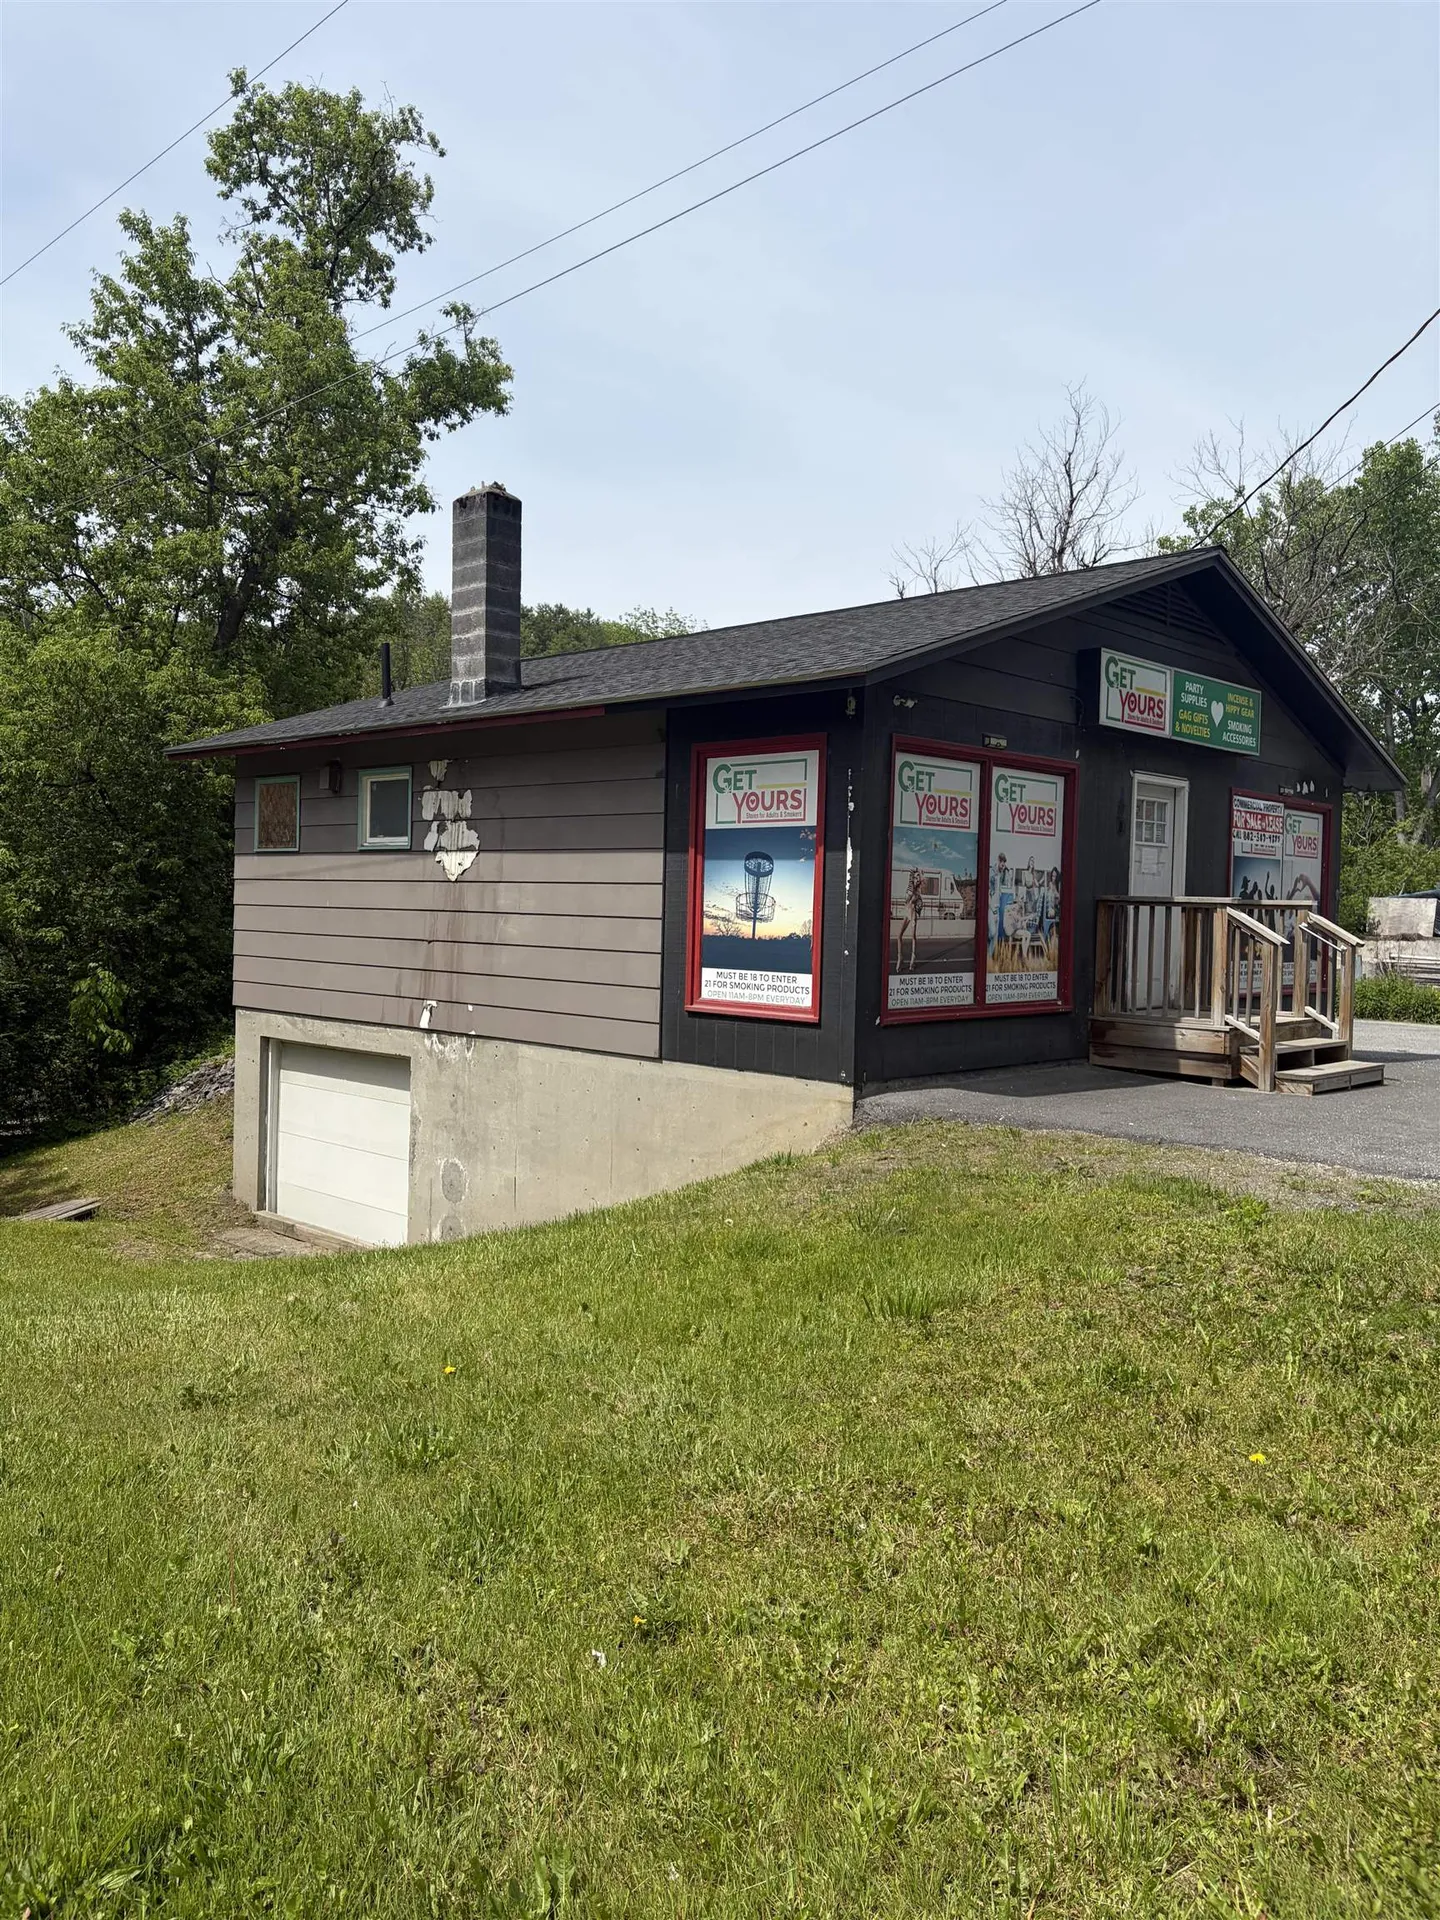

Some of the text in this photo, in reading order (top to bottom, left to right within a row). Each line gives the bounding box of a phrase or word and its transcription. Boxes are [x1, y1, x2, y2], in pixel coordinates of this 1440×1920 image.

[1105, 656, 1136, 690] GET
[1186, 681, 1204, 694] PARTY
[1119, 689, 1163, 722] YOURS
[1181, 693, 1207, 707] SUPPLIES
[1228, 693, 1248, 705] INCENSE
[1179, 709, 1208, 724] GAG GIFTS
[1226, 704, 1254, 718] HIPPY GEAR
[1176, 722, 1210, 738] & NOVELTIES
[1228, 720, 1252, 734] SMOKING
[1223, 732, 1256, 747] ACCESSORIES
[713, 764, 757, 793] GET
[898, 761, 935, 792] GET
[995, 774, 1026, 803] GET
[733, 790, 802, 823] YOURS
[915, 793, 968, 825] YOURS
[1009, 803, 1053, 833] YOURS
[1233, 811, 1245, 827] FOR
[1247, 813, 1261, 829] SALE
[1266, 816, 1283, 832] LEASE
[1285, 813, 1301, 834] GET
[1292, 835, 1317, 856] YOURS
[772, 975, 797, 983] ENTER
[730, 982, 765, 991] SMOKING
[767, 985, 809, 995] PRODUCTS
[911, 986, 939, 995] SMOKING
[941, 985, 972, 993] PRODUCTS
[766, 995, 805, 1004] EVERYDAY
